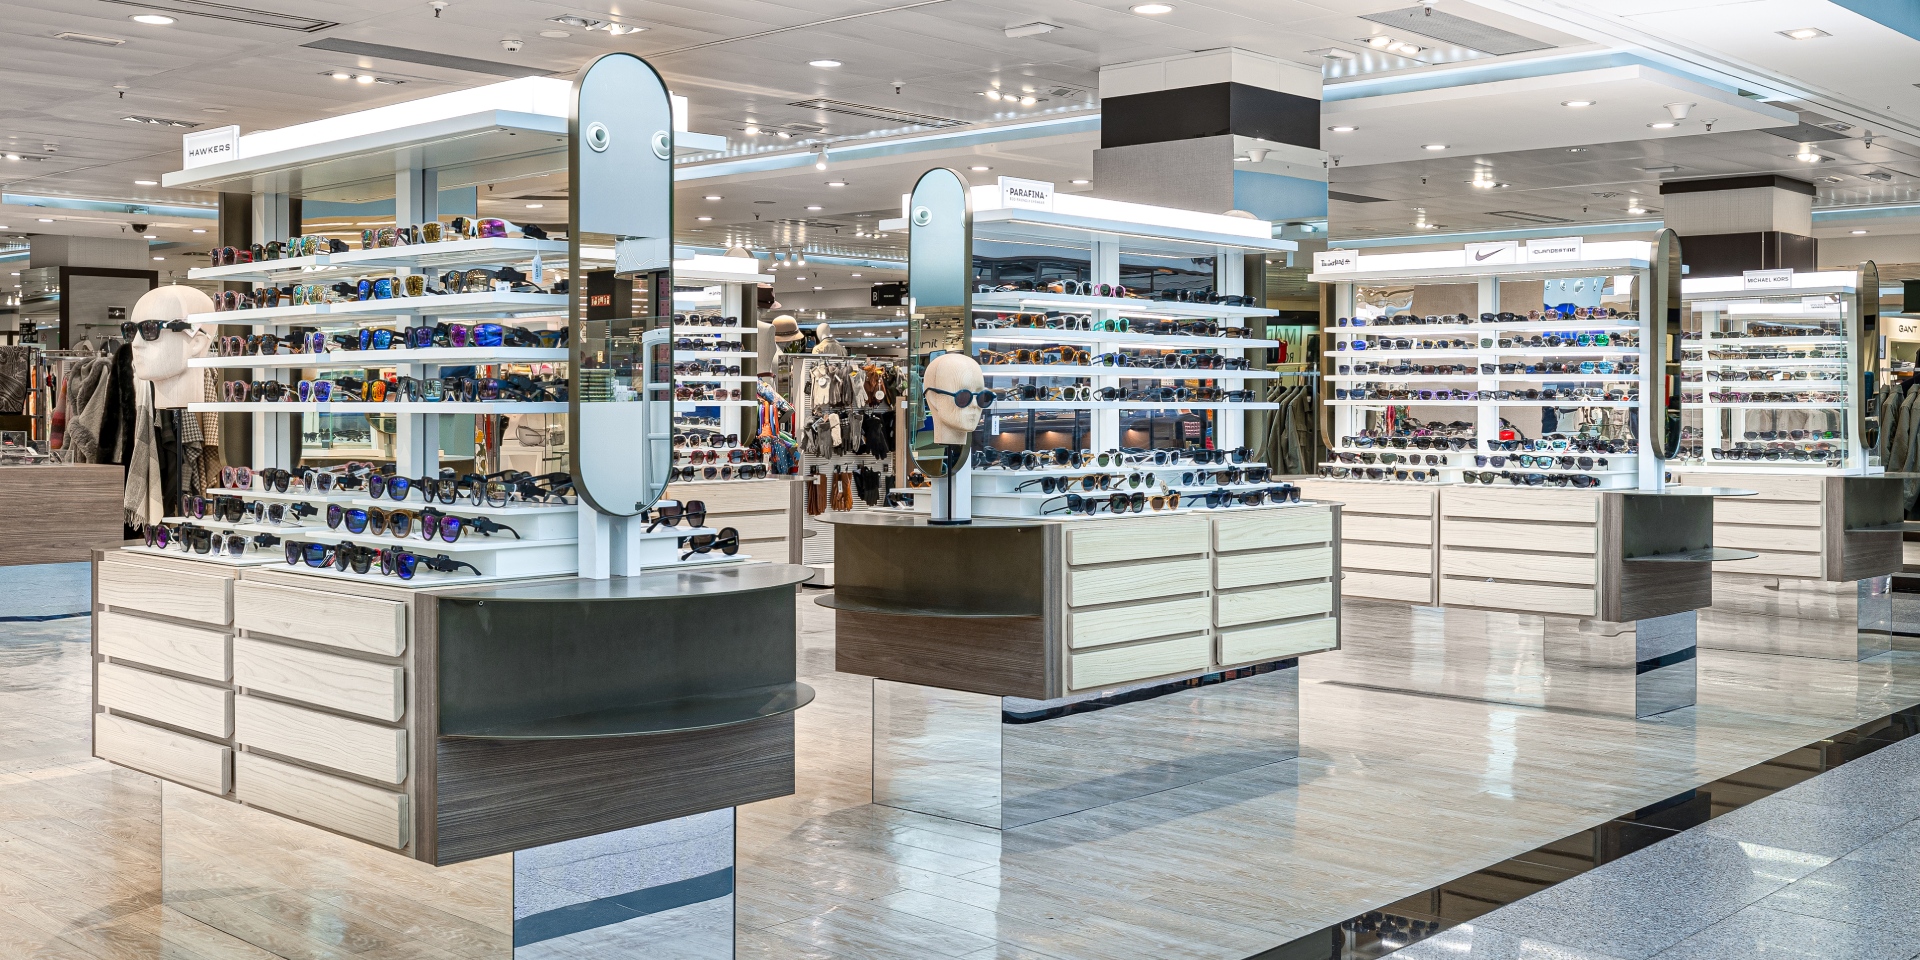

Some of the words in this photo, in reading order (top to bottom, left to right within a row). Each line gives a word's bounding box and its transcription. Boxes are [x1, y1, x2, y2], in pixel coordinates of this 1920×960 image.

[189, 144, 230, 157] HAWKERS
[1010, 188, 1045, 199] PARAFINA
[872, 291, 878, 301] B
[1898, 325, 1918, 333] GANT
